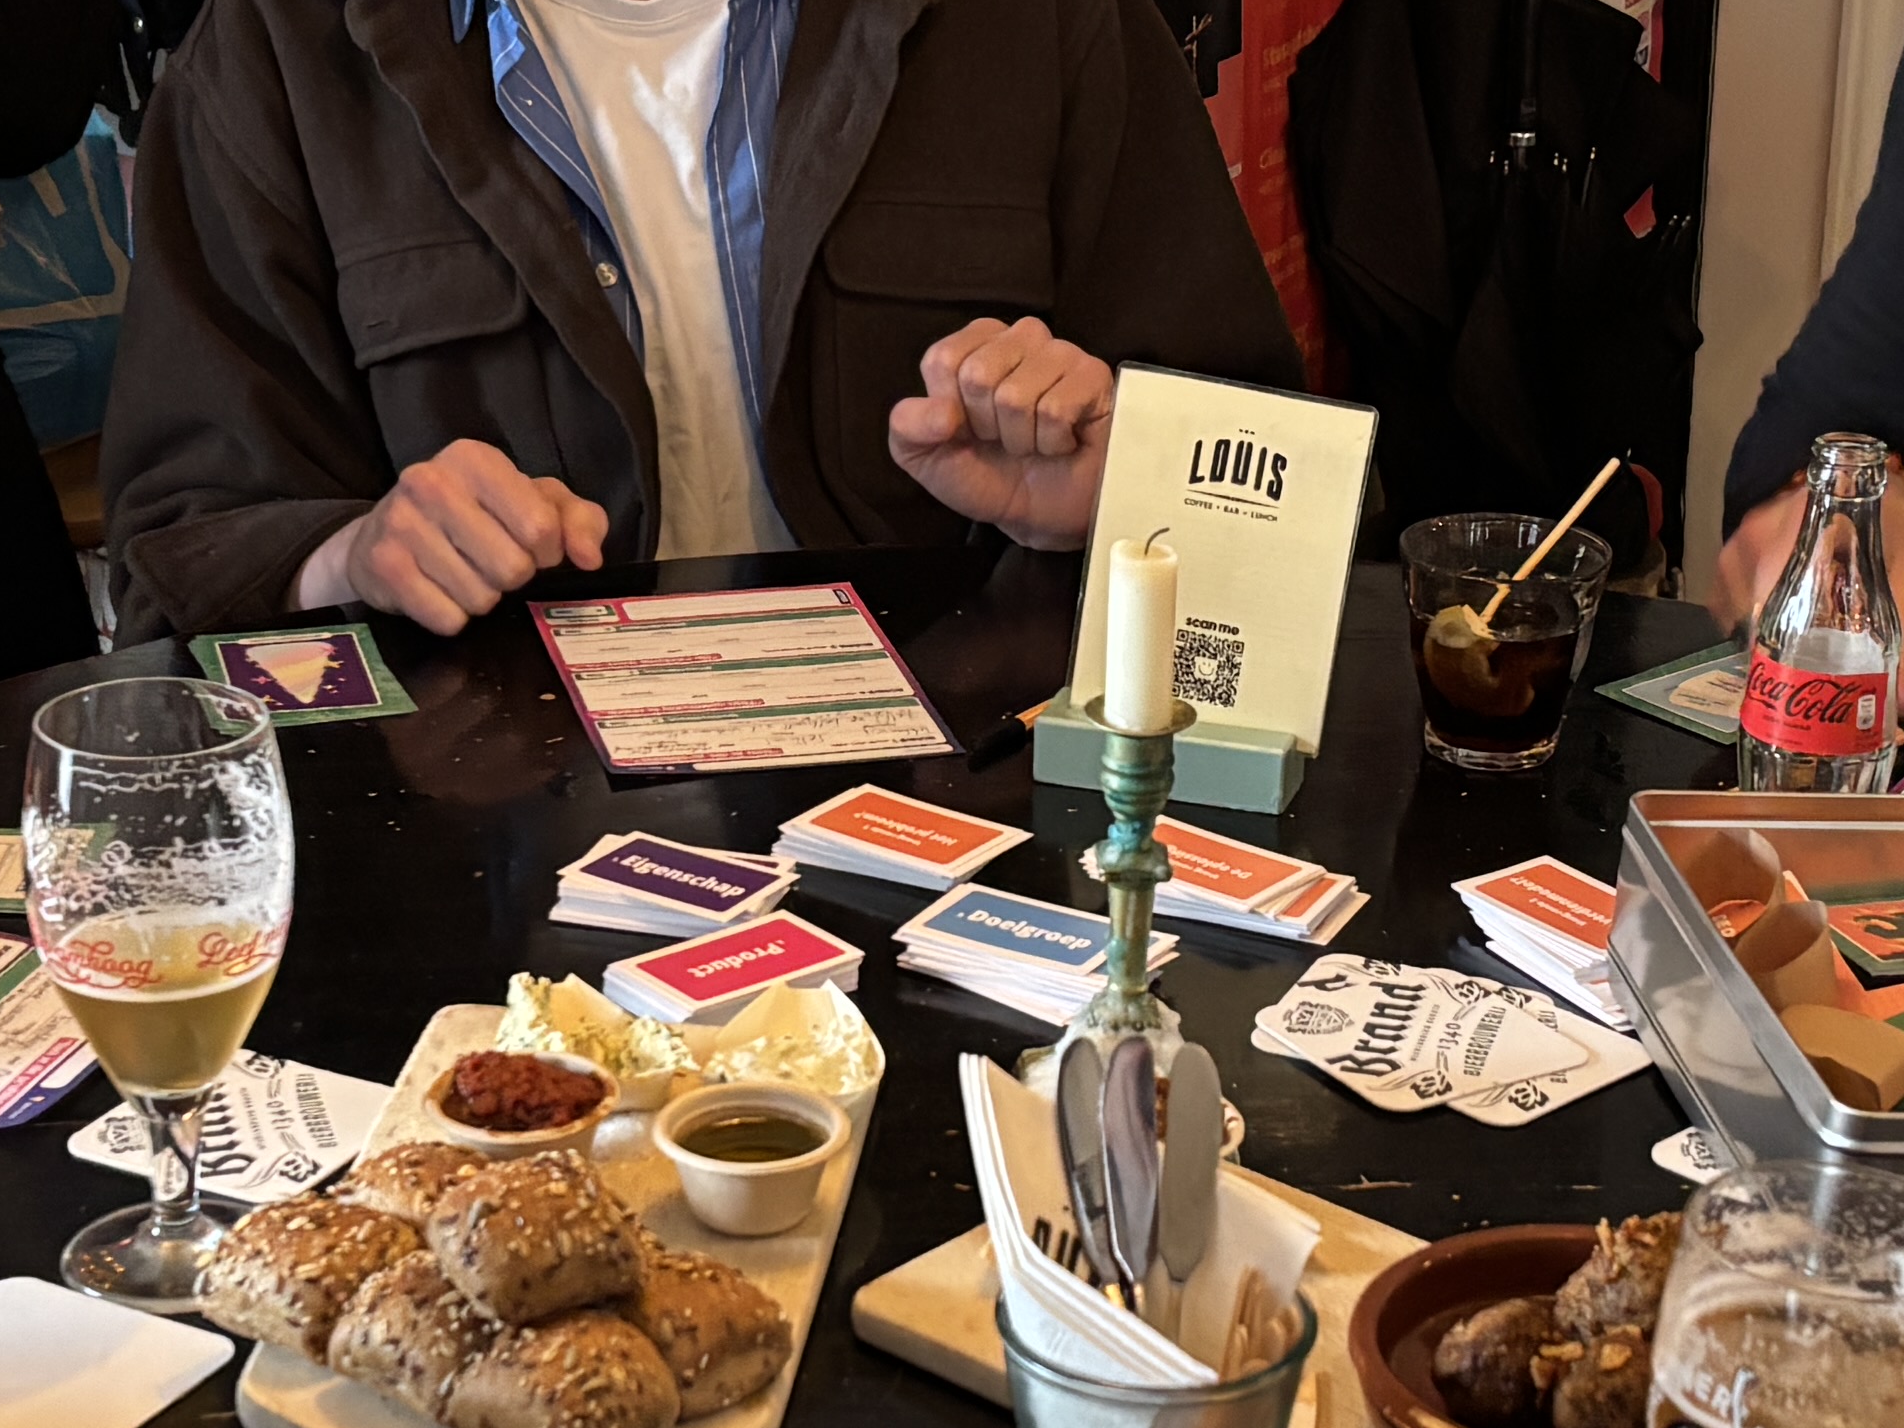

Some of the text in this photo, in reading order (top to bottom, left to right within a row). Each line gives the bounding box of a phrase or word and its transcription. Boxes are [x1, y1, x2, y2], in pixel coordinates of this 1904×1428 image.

[1188, 438, 1289, 502] LOUIS
[1184, 497, 1279, 523] COFFEE BAR LUNCH
[1185, 616, 1241, 636] scan me
[622, 853, 746, 900] Eigenschap
[968, 908, 1093, 952] Doelgroep
[687, 938, 787, 979] Product
[1324, 980, 1429, 1077] Brand
[1436, 1022, 1461, 1051] 1340
[1462, 1005, 1507, 1077] BIERBROUWERIJ
[265, 1099, 295, 1131] 1340
[296, 1072, 338, 1149] BIERBROUWERIJ
